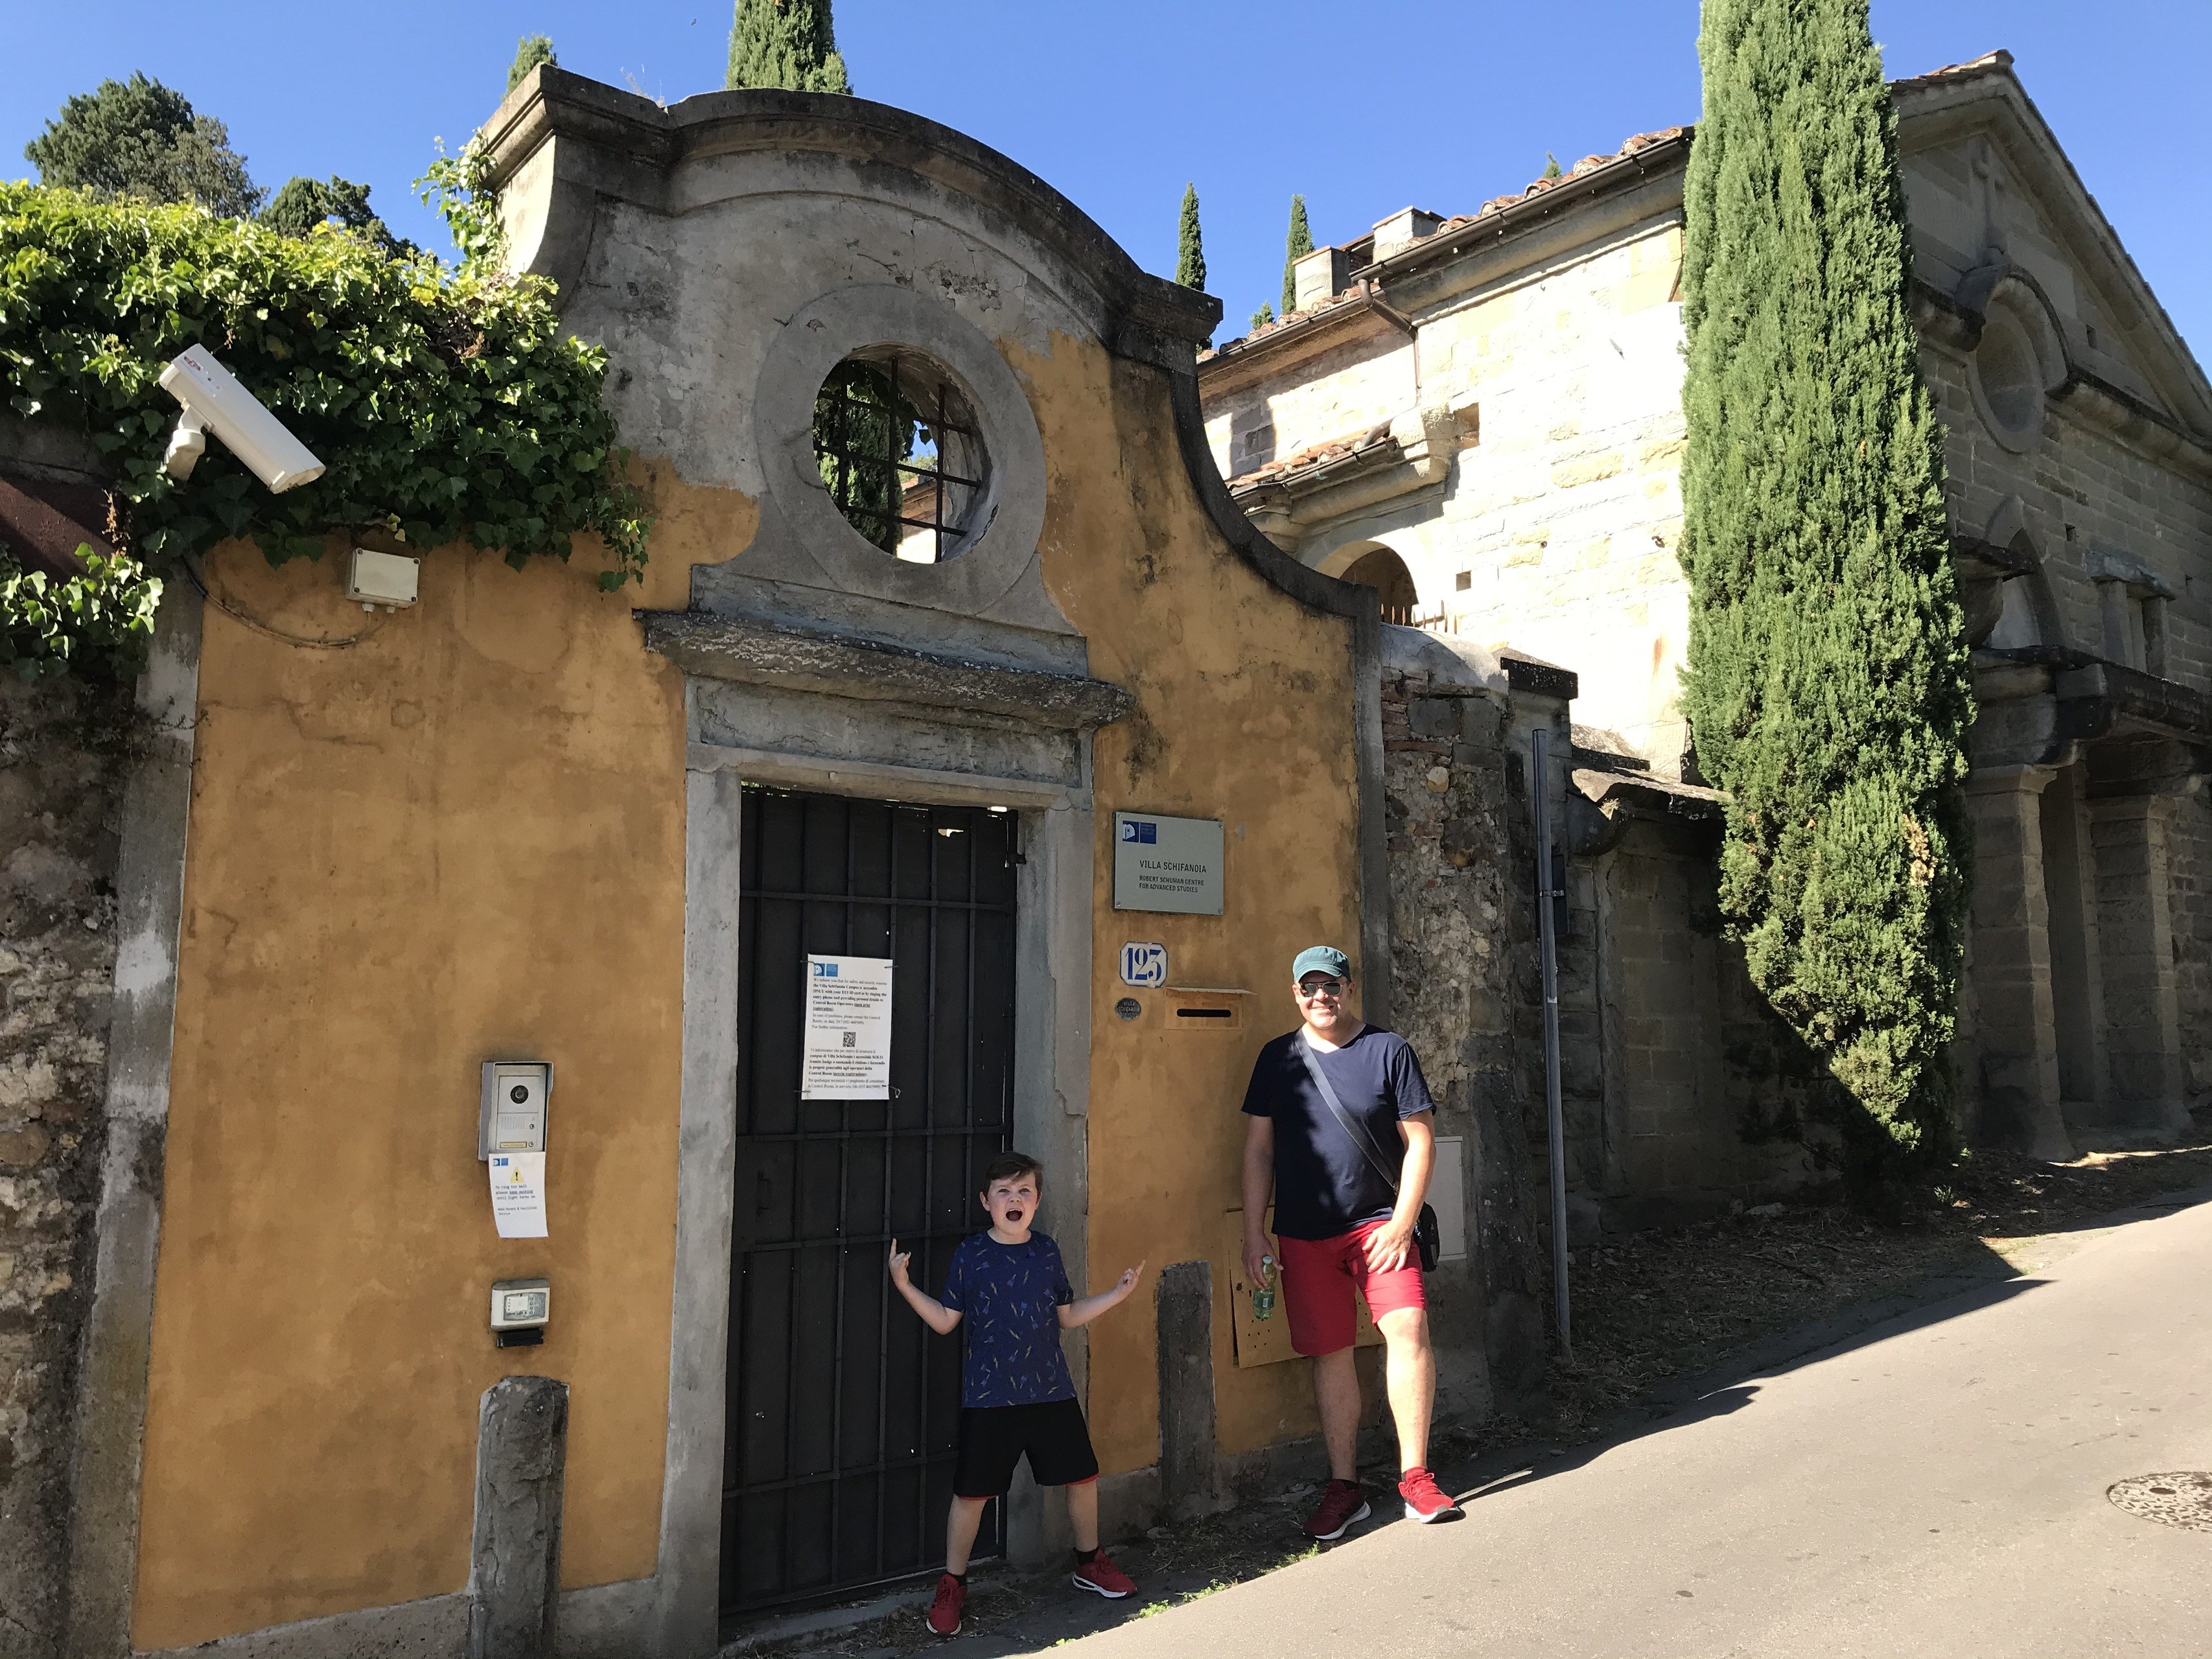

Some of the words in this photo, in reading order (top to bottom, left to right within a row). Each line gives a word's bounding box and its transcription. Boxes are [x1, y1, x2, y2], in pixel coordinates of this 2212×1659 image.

[1139, 859, 1161, 869] VILLA
[1163, 861, 1207, 873] SCHIFANOIA
[1125, 947, 1162, 982] 123
